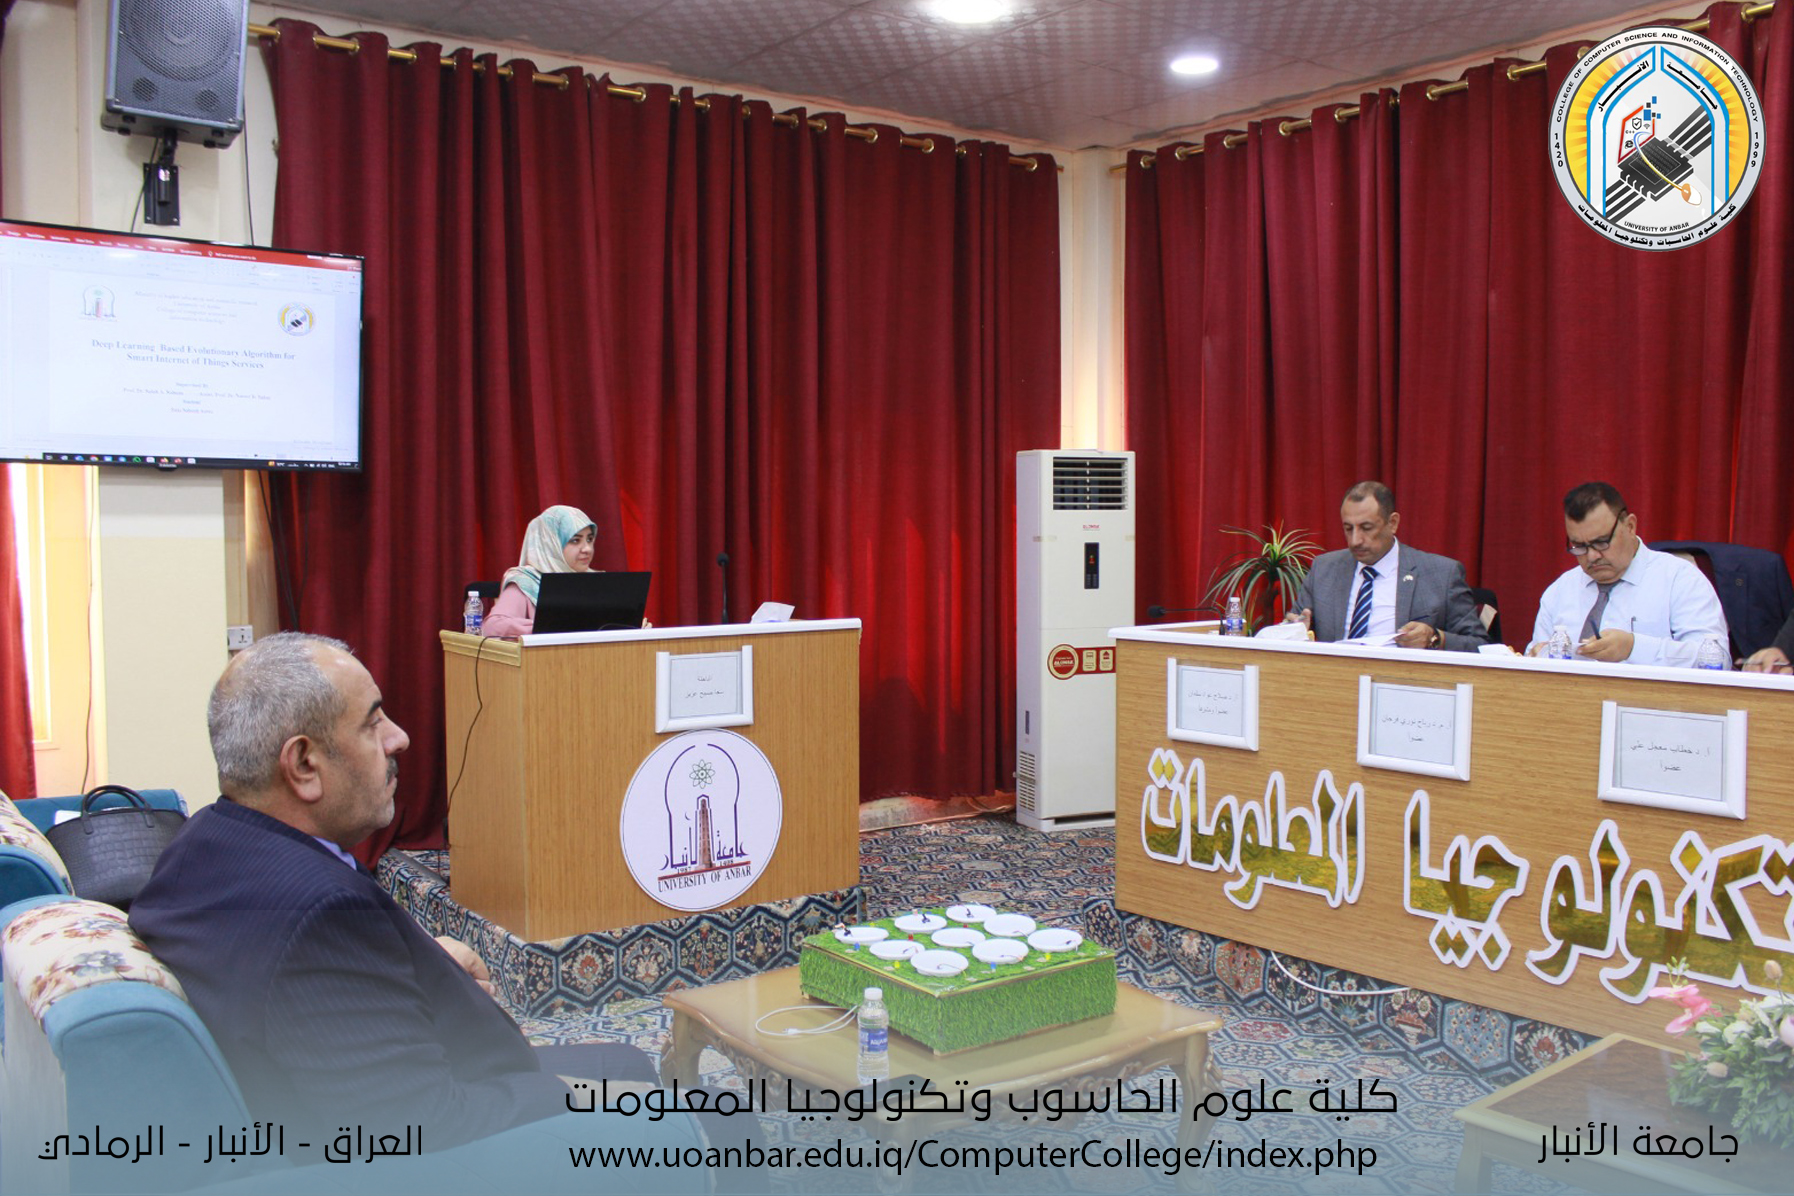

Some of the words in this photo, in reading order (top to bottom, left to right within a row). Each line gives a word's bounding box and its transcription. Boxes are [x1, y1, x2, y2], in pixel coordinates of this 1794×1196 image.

[92, 338, 114, 350] Deep
[116, 341, 155, 353] Learning
[160, 344, 185, 353] Based
[187, 345, 239, 358] Evolutionary
[243, 349, 282, 360] Algorithm
[283, 351, 296, 360] for
[126, 353, 154, 363] Smart
[155, 354, 190, 365] Internet
[192, 356, 201, 365] of
[202, 357, 230, 368] Things
[231, 359, 265, 369] Services
[658, 873, 707, 893] UNIVERSITY
[710, 871, 721, 883] OF
[724, 865, 752, 881] ANBAR
